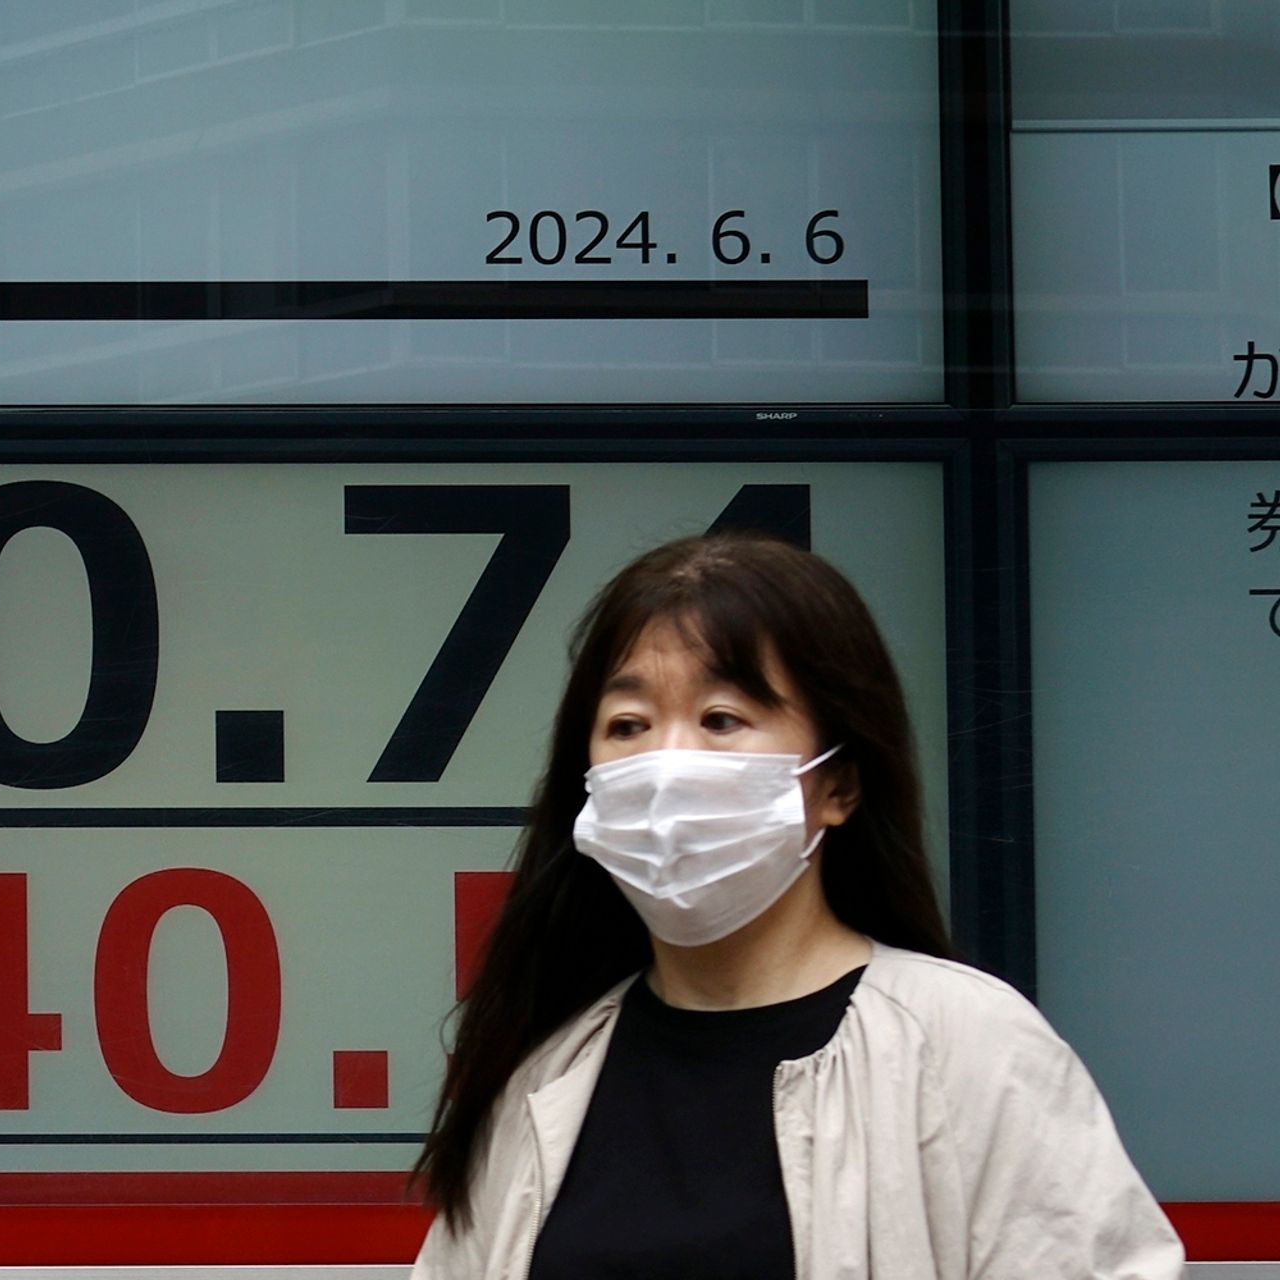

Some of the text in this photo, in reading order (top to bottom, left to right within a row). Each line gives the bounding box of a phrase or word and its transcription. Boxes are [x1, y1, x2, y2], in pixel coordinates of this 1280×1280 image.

[483, 210, 679, 267] 2024.
[804, 210, 847, 267] 6
[755, 411, 798, 421] SHARP
